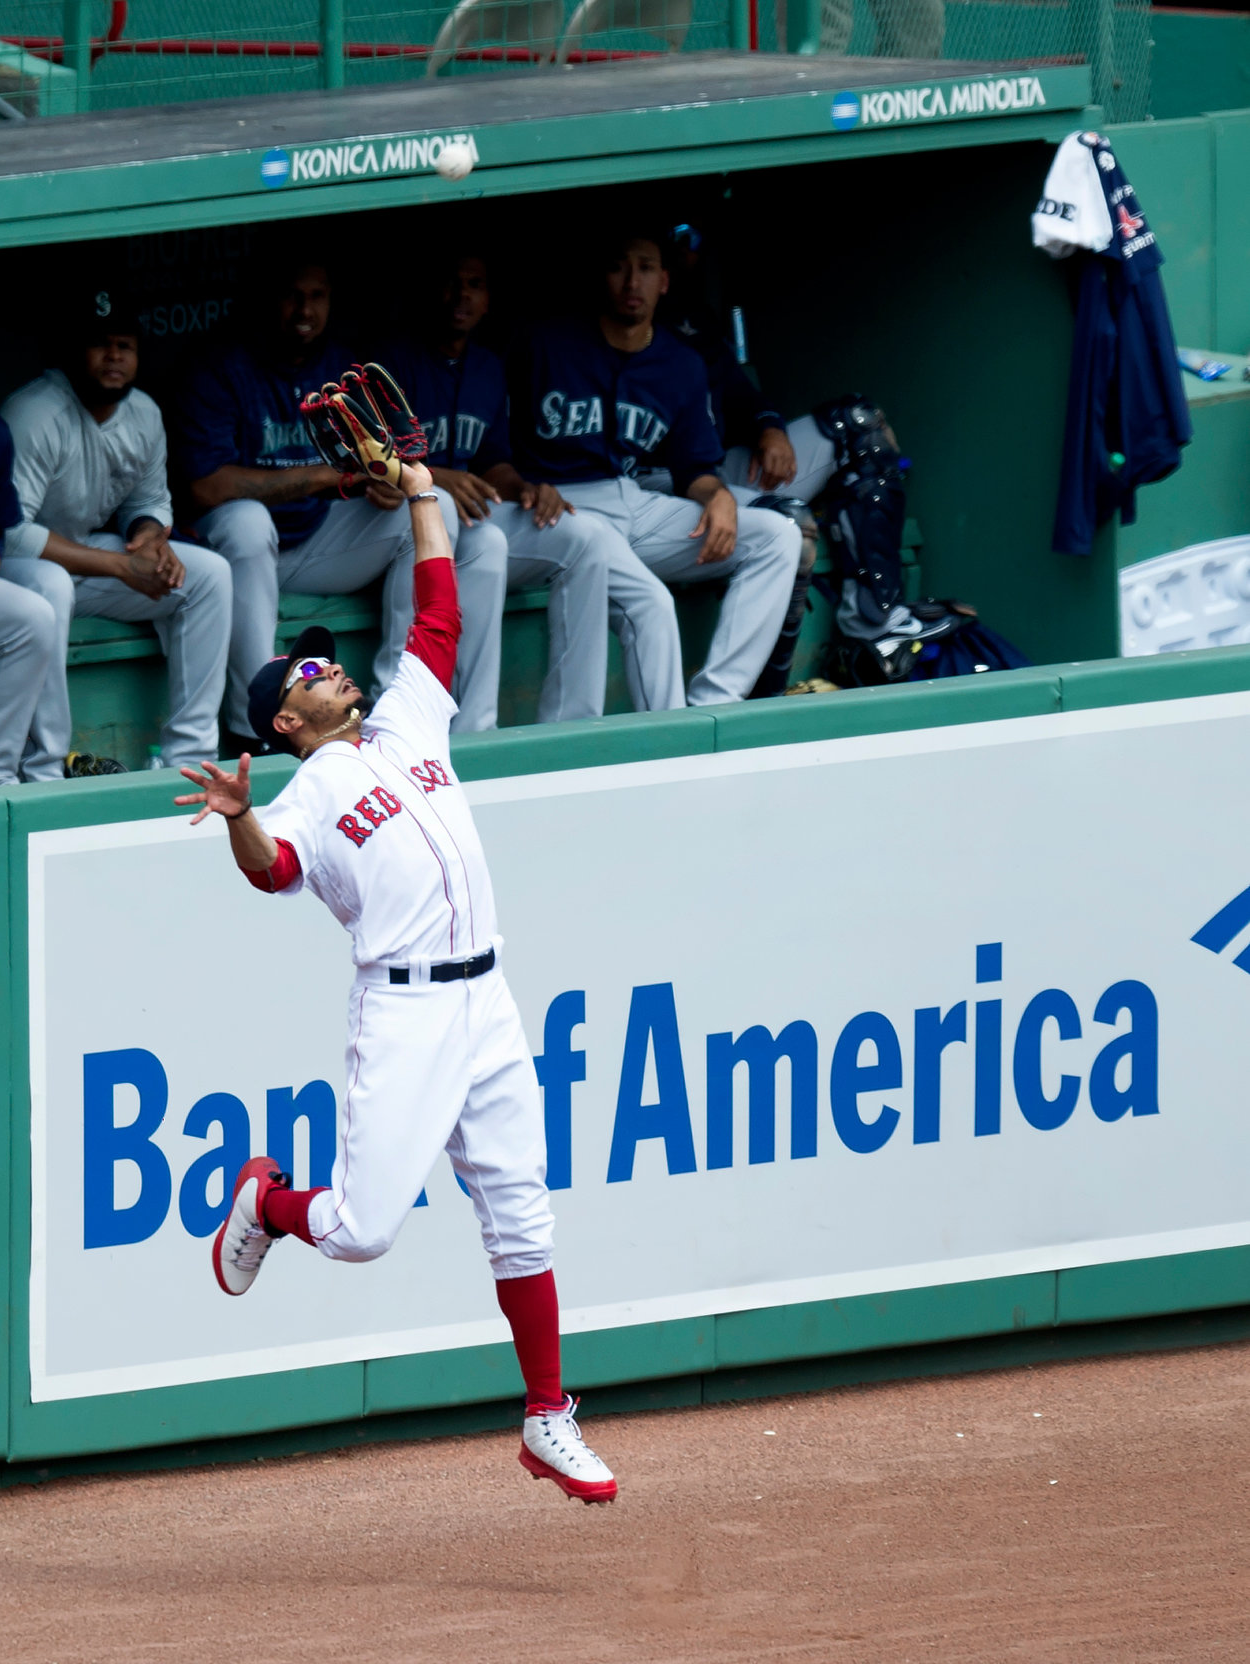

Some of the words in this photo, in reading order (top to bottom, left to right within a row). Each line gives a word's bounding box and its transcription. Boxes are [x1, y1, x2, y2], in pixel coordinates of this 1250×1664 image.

[861, 87, 947, 124] KONICA
[950, 76, 1046, 115] MINOLTA
[292, 144, 379, 181] KONICA
[336, 785, 403, 848] RED
[84, 1047, 428, 1250] Ban
[606, 941, 1161, 1184] America
